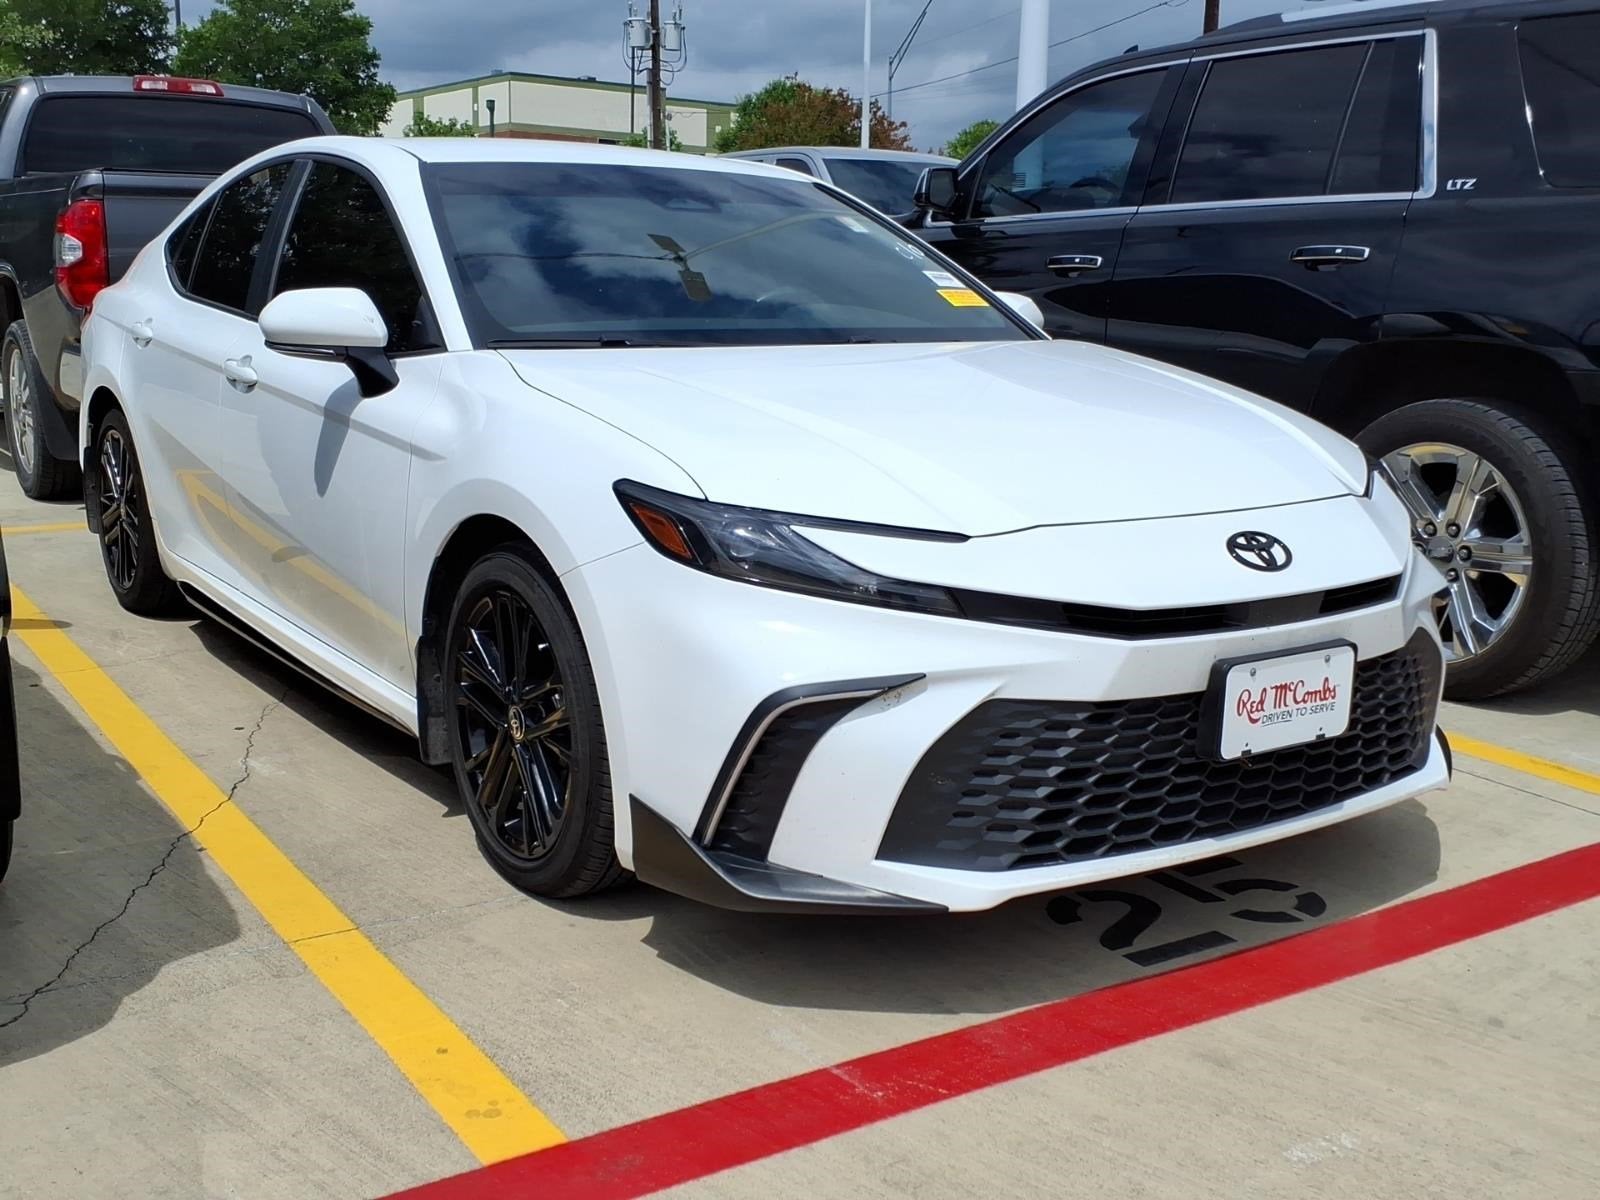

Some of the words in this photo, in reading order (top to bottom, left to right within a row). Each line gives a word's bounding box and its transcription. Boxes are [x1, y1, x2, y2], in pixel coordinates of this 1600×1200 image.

[1446, 178, 1477, 190] LTZ
[1237, 688, 1266, 724] Red
[1270, 677, 1336, 709] McCombs
[1261, 710, 1293, 724] DRIVEN
[1296, 706, 1306, 717] TO
[1309, 702, 1336, 715] SERVE
